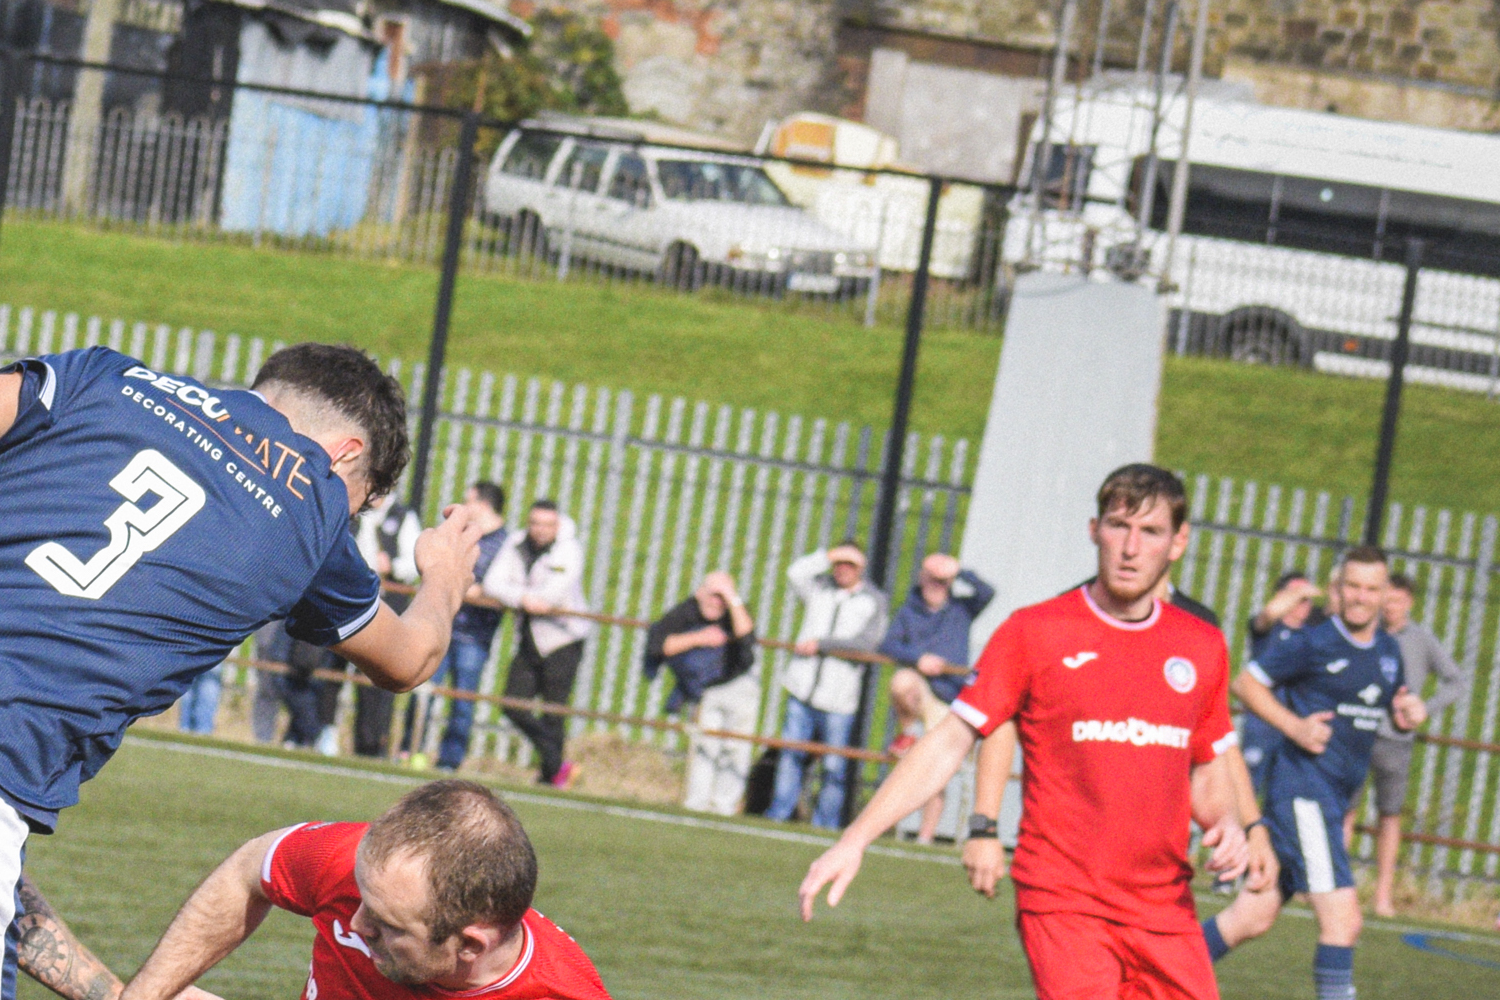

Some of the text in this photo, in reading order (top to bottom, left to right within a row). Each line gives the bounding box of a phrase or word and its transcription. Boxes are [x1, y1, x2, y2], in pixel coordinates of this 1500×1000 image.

[121, 385, 283, 518] DECORATING CENTRE
[24, 449, 206, 599] 3
